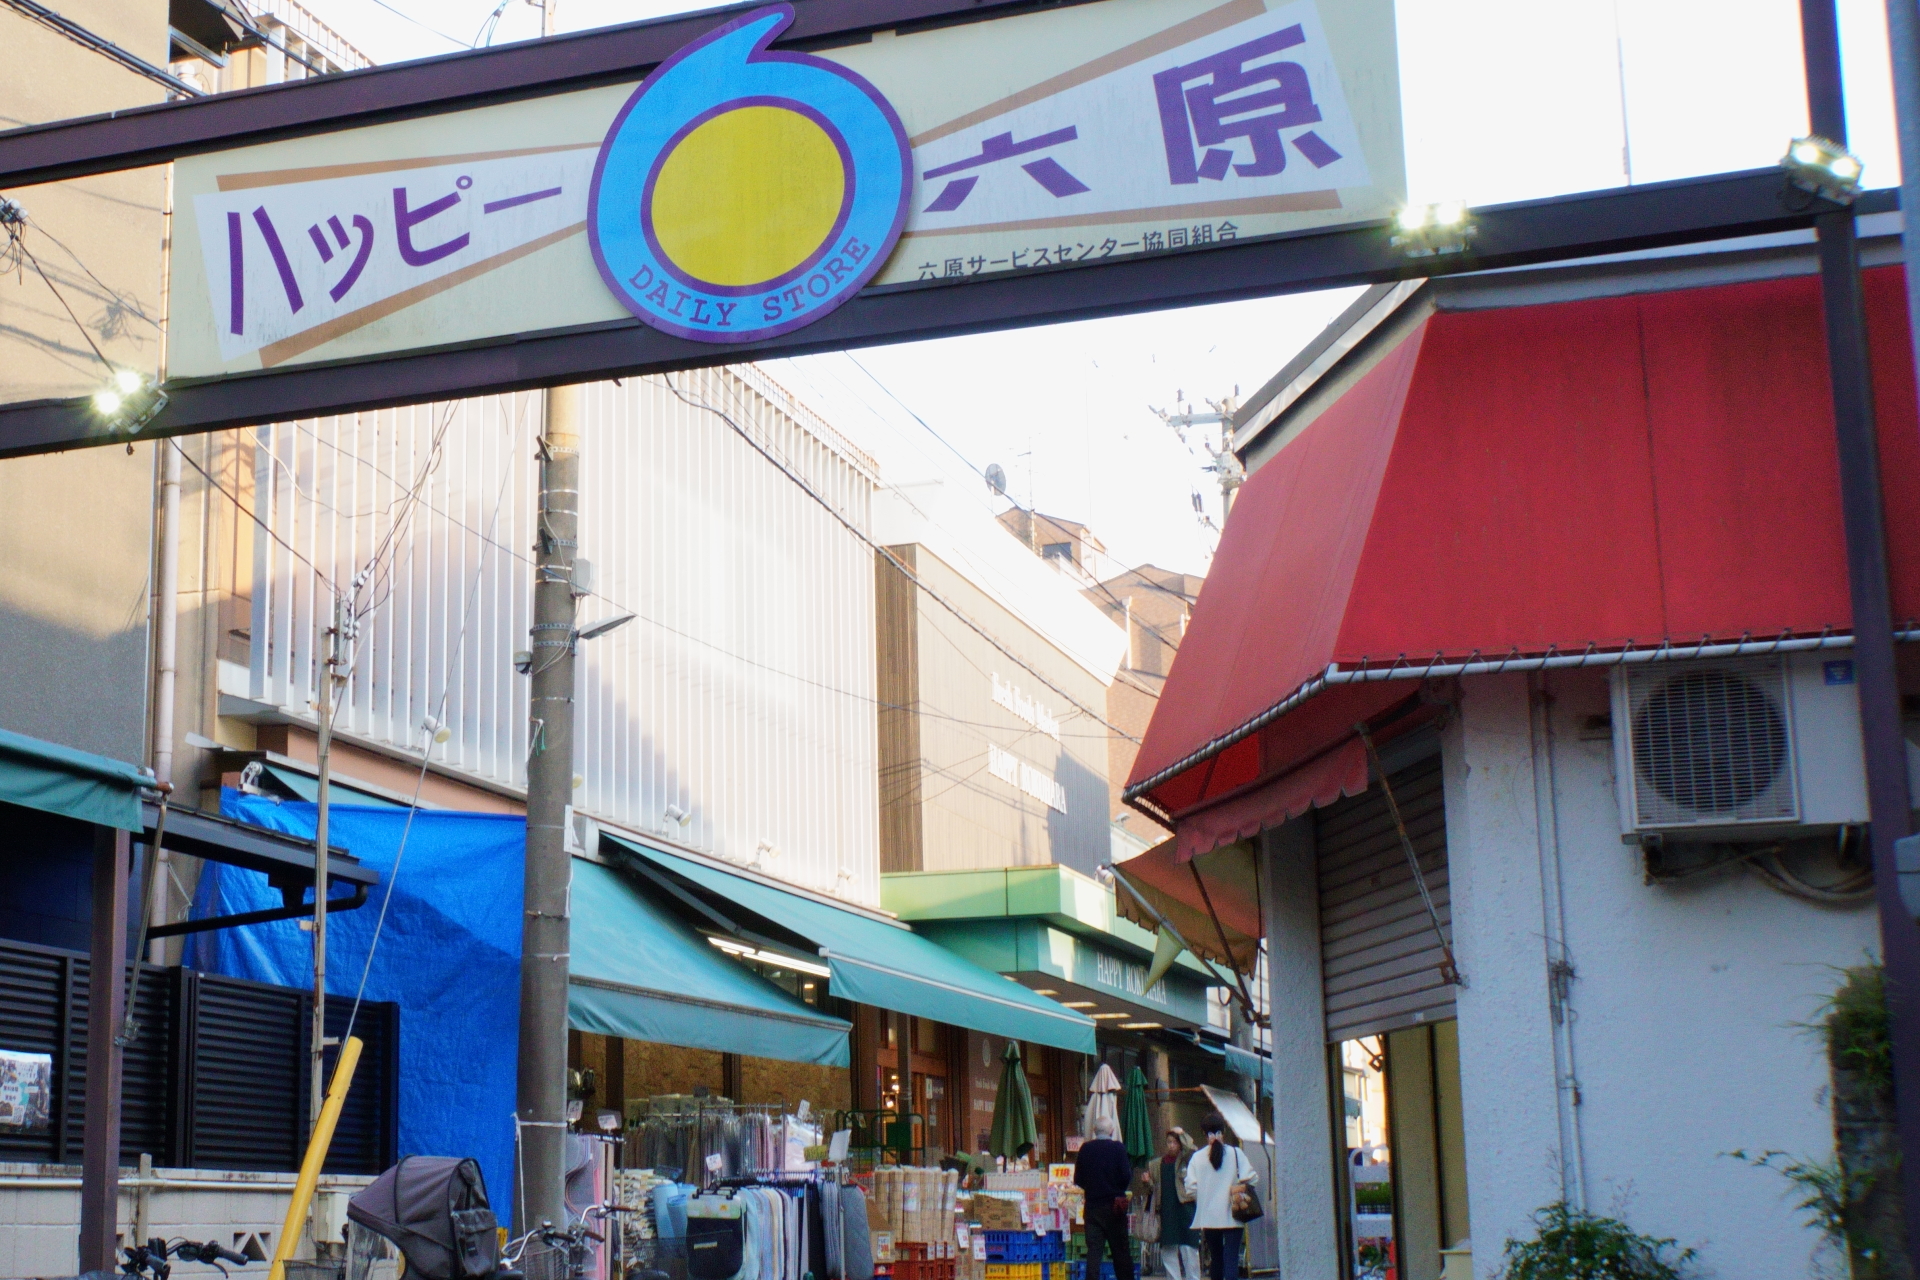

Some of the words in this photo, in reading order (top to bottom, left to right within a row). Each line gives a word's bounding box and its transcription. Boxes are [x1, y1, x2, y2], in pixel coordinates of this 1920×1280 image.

[922, 23, 1343, 213] 六原
[226, 175, 563, 336] ハッピー
[629, 264, 739, 327] DAILY
[761, 236, 870, 321] STORE
[917, 220, 1239, 283] 六原サービスセンター協同組合
[1097, 952, 1123, 990] HAPPY
